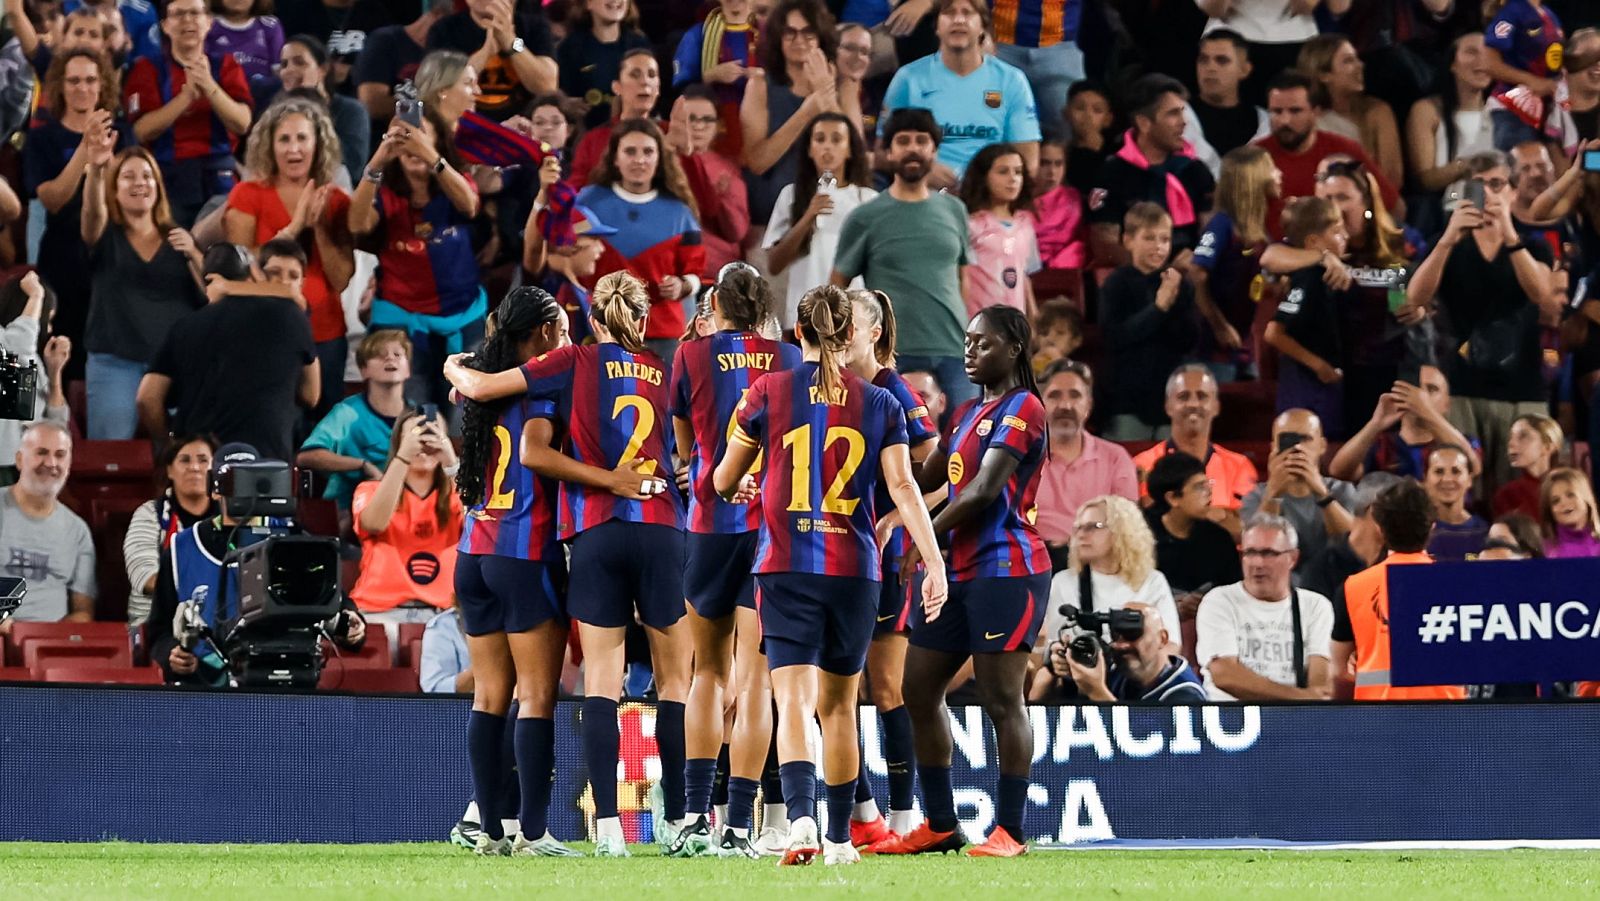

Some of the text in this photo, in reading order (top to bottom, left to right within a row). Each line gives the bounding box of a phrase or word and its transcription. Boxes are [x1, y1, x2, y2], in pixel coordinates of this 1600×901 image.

[605, 360, 663, 386] PAREDES
[717, 352, 775, 372] SYDNEY
[611, 394, 658, 478] 2
[782, 423, 865, 516] 12
